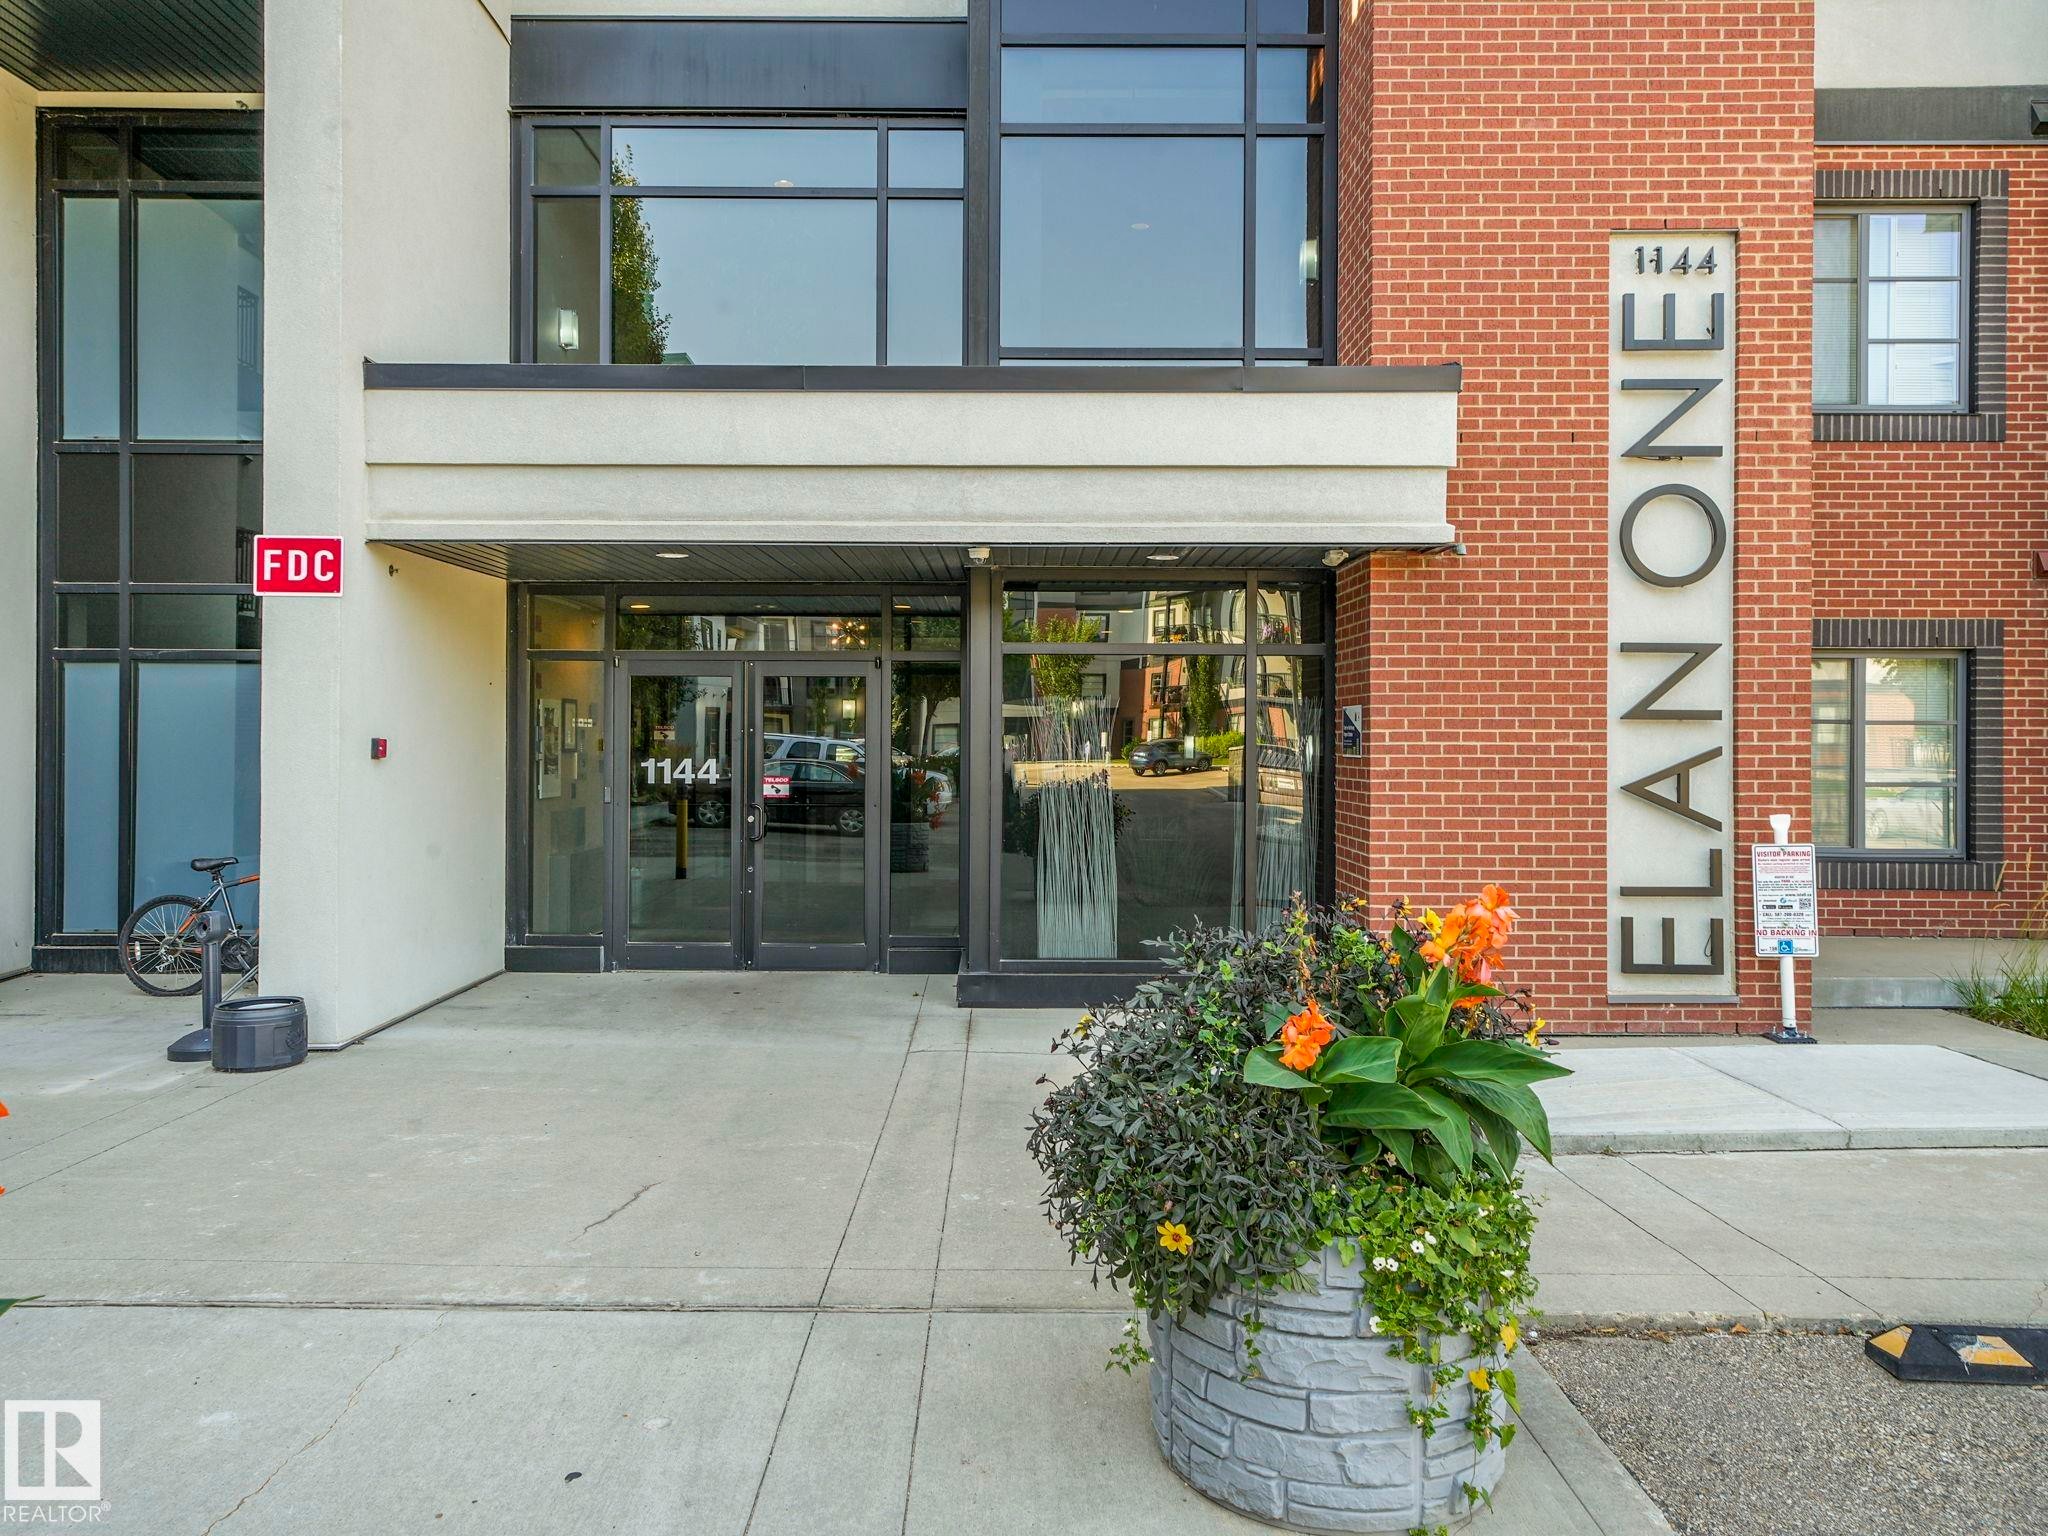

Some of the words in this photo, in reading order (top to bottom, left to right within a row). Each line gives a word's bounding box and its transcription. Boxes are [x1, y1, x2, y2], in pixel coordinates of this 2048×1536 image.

[1634, 246, 1718, 275] 1144
[263, 549, 335, 582] FDC
[640, 758, 720, 784] 1144
